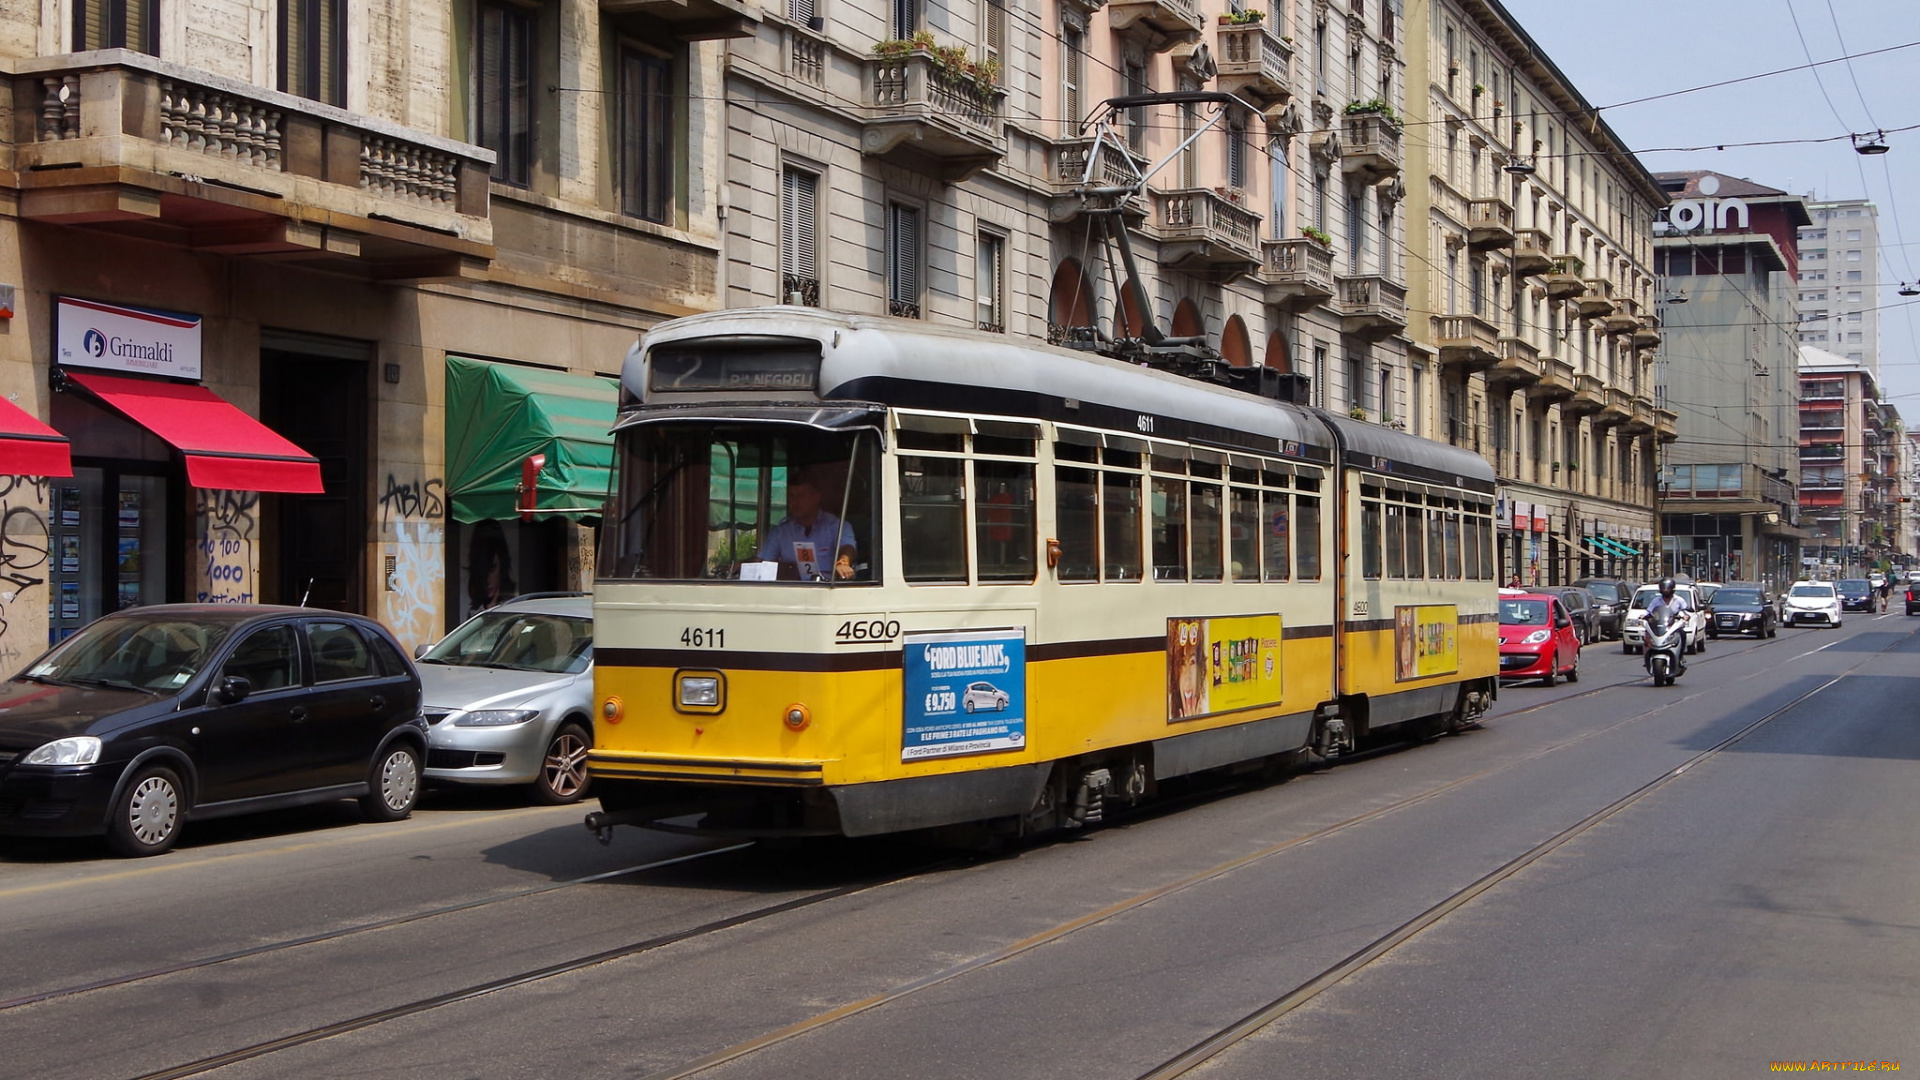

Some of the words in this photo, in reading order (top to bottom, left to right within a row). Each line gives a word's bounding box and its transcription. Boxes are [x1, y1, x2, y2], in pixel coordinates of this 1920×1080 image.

[1653, 175, 1749, 231] oin
[110, 336, 173, 362] Grimaldi
[1137, 414, 1154, 433] 4611
[804, 563, 813, 575] 2
[681, 628, 725, 648] 4611
[836, 620, 900, 640] 4600
[957, 645, 980, 668] BLUE
[969, 741, 991, 749] Provincia
